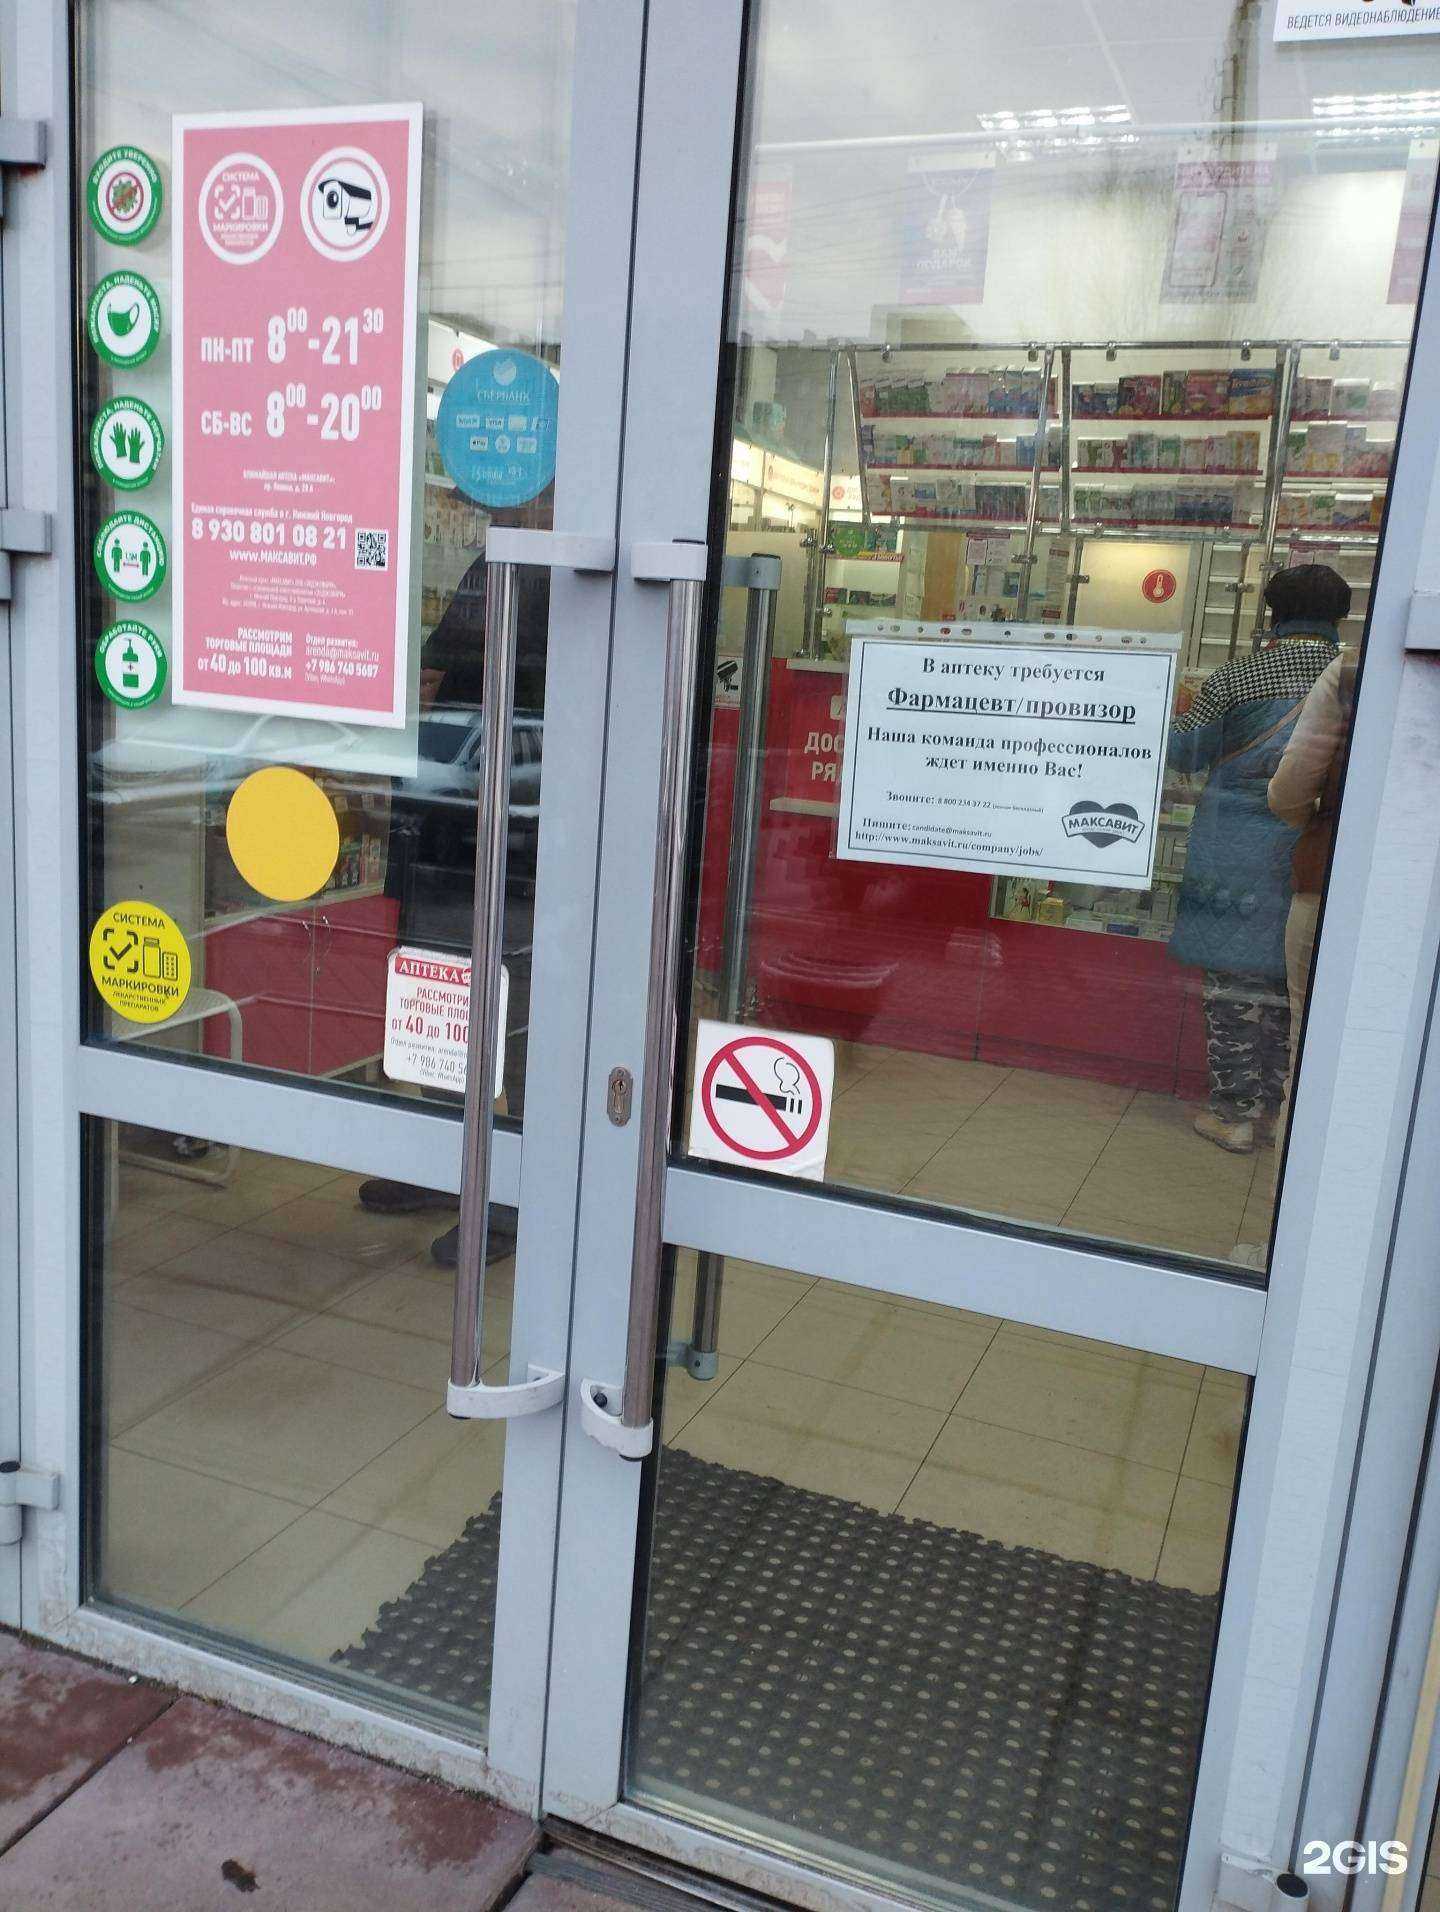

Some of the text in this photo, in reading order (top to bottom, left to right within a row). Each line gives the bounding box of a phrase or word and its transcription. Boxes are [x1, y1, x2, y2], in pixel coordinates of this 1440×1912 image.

[1287, 7, 1440, 30] ВЕДЕТСЯ ВИДЕОНАБЛЮДЕНИЕ
[222, 171, 260, 181] СИСТЕМА
[201, 337, 254, 363] ПН-ПТ
[201, 410, 252, 437] СБ-ВС
[253, 507, 279, 519] служба
[292, 509, 320, 521] Нижний
[321, 510, 353, 524] Новгород
[191, 519, 346, 550] 8 930 801 08 21
[206, 636, 293, 657] ТОРГОВЫЕ ПЛОЩАДИ
[237, 627, 293, 643] РАССМОТРИМ
[210, 652, 227, 673] 40
[228, 660, 242, 676] до
[243, 656, 267, 677] 100
[305, 658, 317, 672] +7
[922, 657, 1105, 682] В аптеку требуется
[887, 687, 1136, 723] Фармацевт/провизор
[804, 731, 845, 755] ДОС
[867, 726, 1152, 760] Наша команда профессионалов
[811, 761, 839, 786] РЯ
[925, 754, 1084, 779] ждет именно Вас!
[886, 790, 935, 805] Звоните:
[982, 801, 991, 809] 22
[862, 817, 911, 831] Пишите:
[1068, 816, 1139, 834] МАКСАВИТ
[855, 830, 1044, 857] http://www.maksavit.ru/company/jobs/
[113, 912, 165, 930] СИСТЕМА
[399, 960, 460, 983] АПТЕКА
[101, 975, 179, 998] МАРКИРОВКИ
[417, 986, 470, 1008] РАССМОТРИ
[400, 997, 469, 1021] ТОРГОВЫЕ ПЛО
[405, 1015, 424, 1035] 40
[426, 1024, 440, 1040] до
[420, 1055, 436, 1069] 986
[439, 1058, 455, 1072] 740
